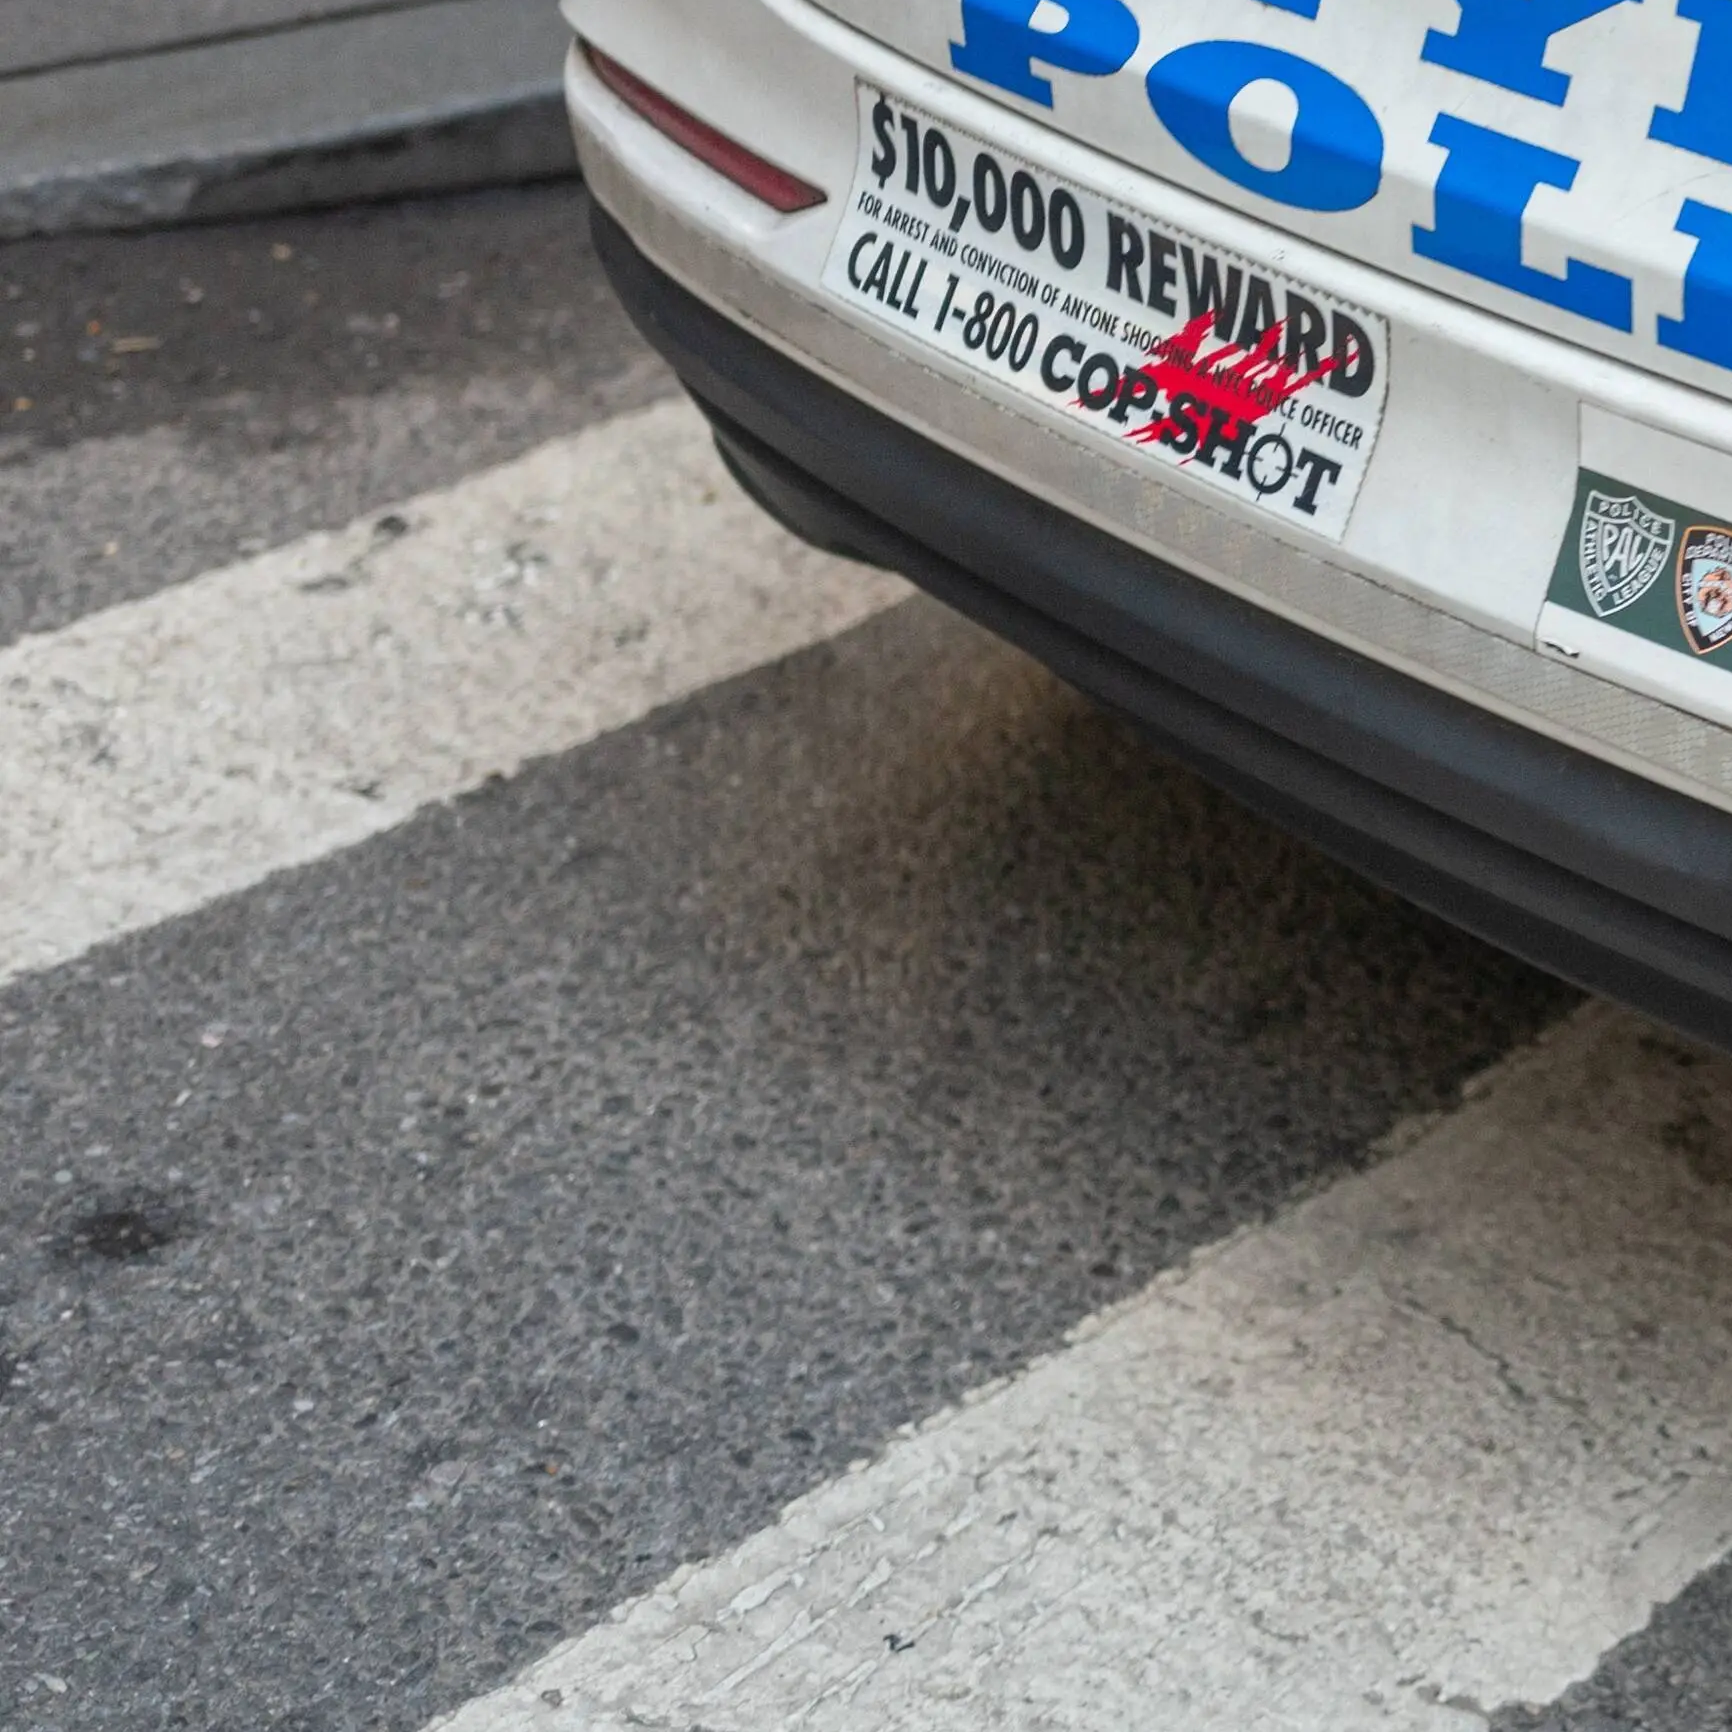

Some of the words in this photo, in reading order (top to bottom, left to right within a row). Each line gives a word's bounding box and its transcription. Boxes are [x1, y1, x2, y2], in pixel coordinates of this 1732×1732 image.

[847, 231, 929, 320] CALL
[933, 272, 1040, 374] 1-800
[857, 190, 882, 218] FOR
[883, 203, 931, 245] ARREST
[930, 229, 958, 257] AND
[960, 244, 1041, 299] CONVICTION
[1041, 283, 1062, 305] OF
[1061, 294, 1119, 338] ANYONE
[1120, 321, 1195, 371] SHOOTING
[1247, 379, 1300, 420] POLICE
[1301, 404, 1364, 450] OFFICER
[871, 91, 1085, 270] $10,000
[1106, 210, 1375, 398] REWARD
[1602, 524, 1645, 580] PAL
